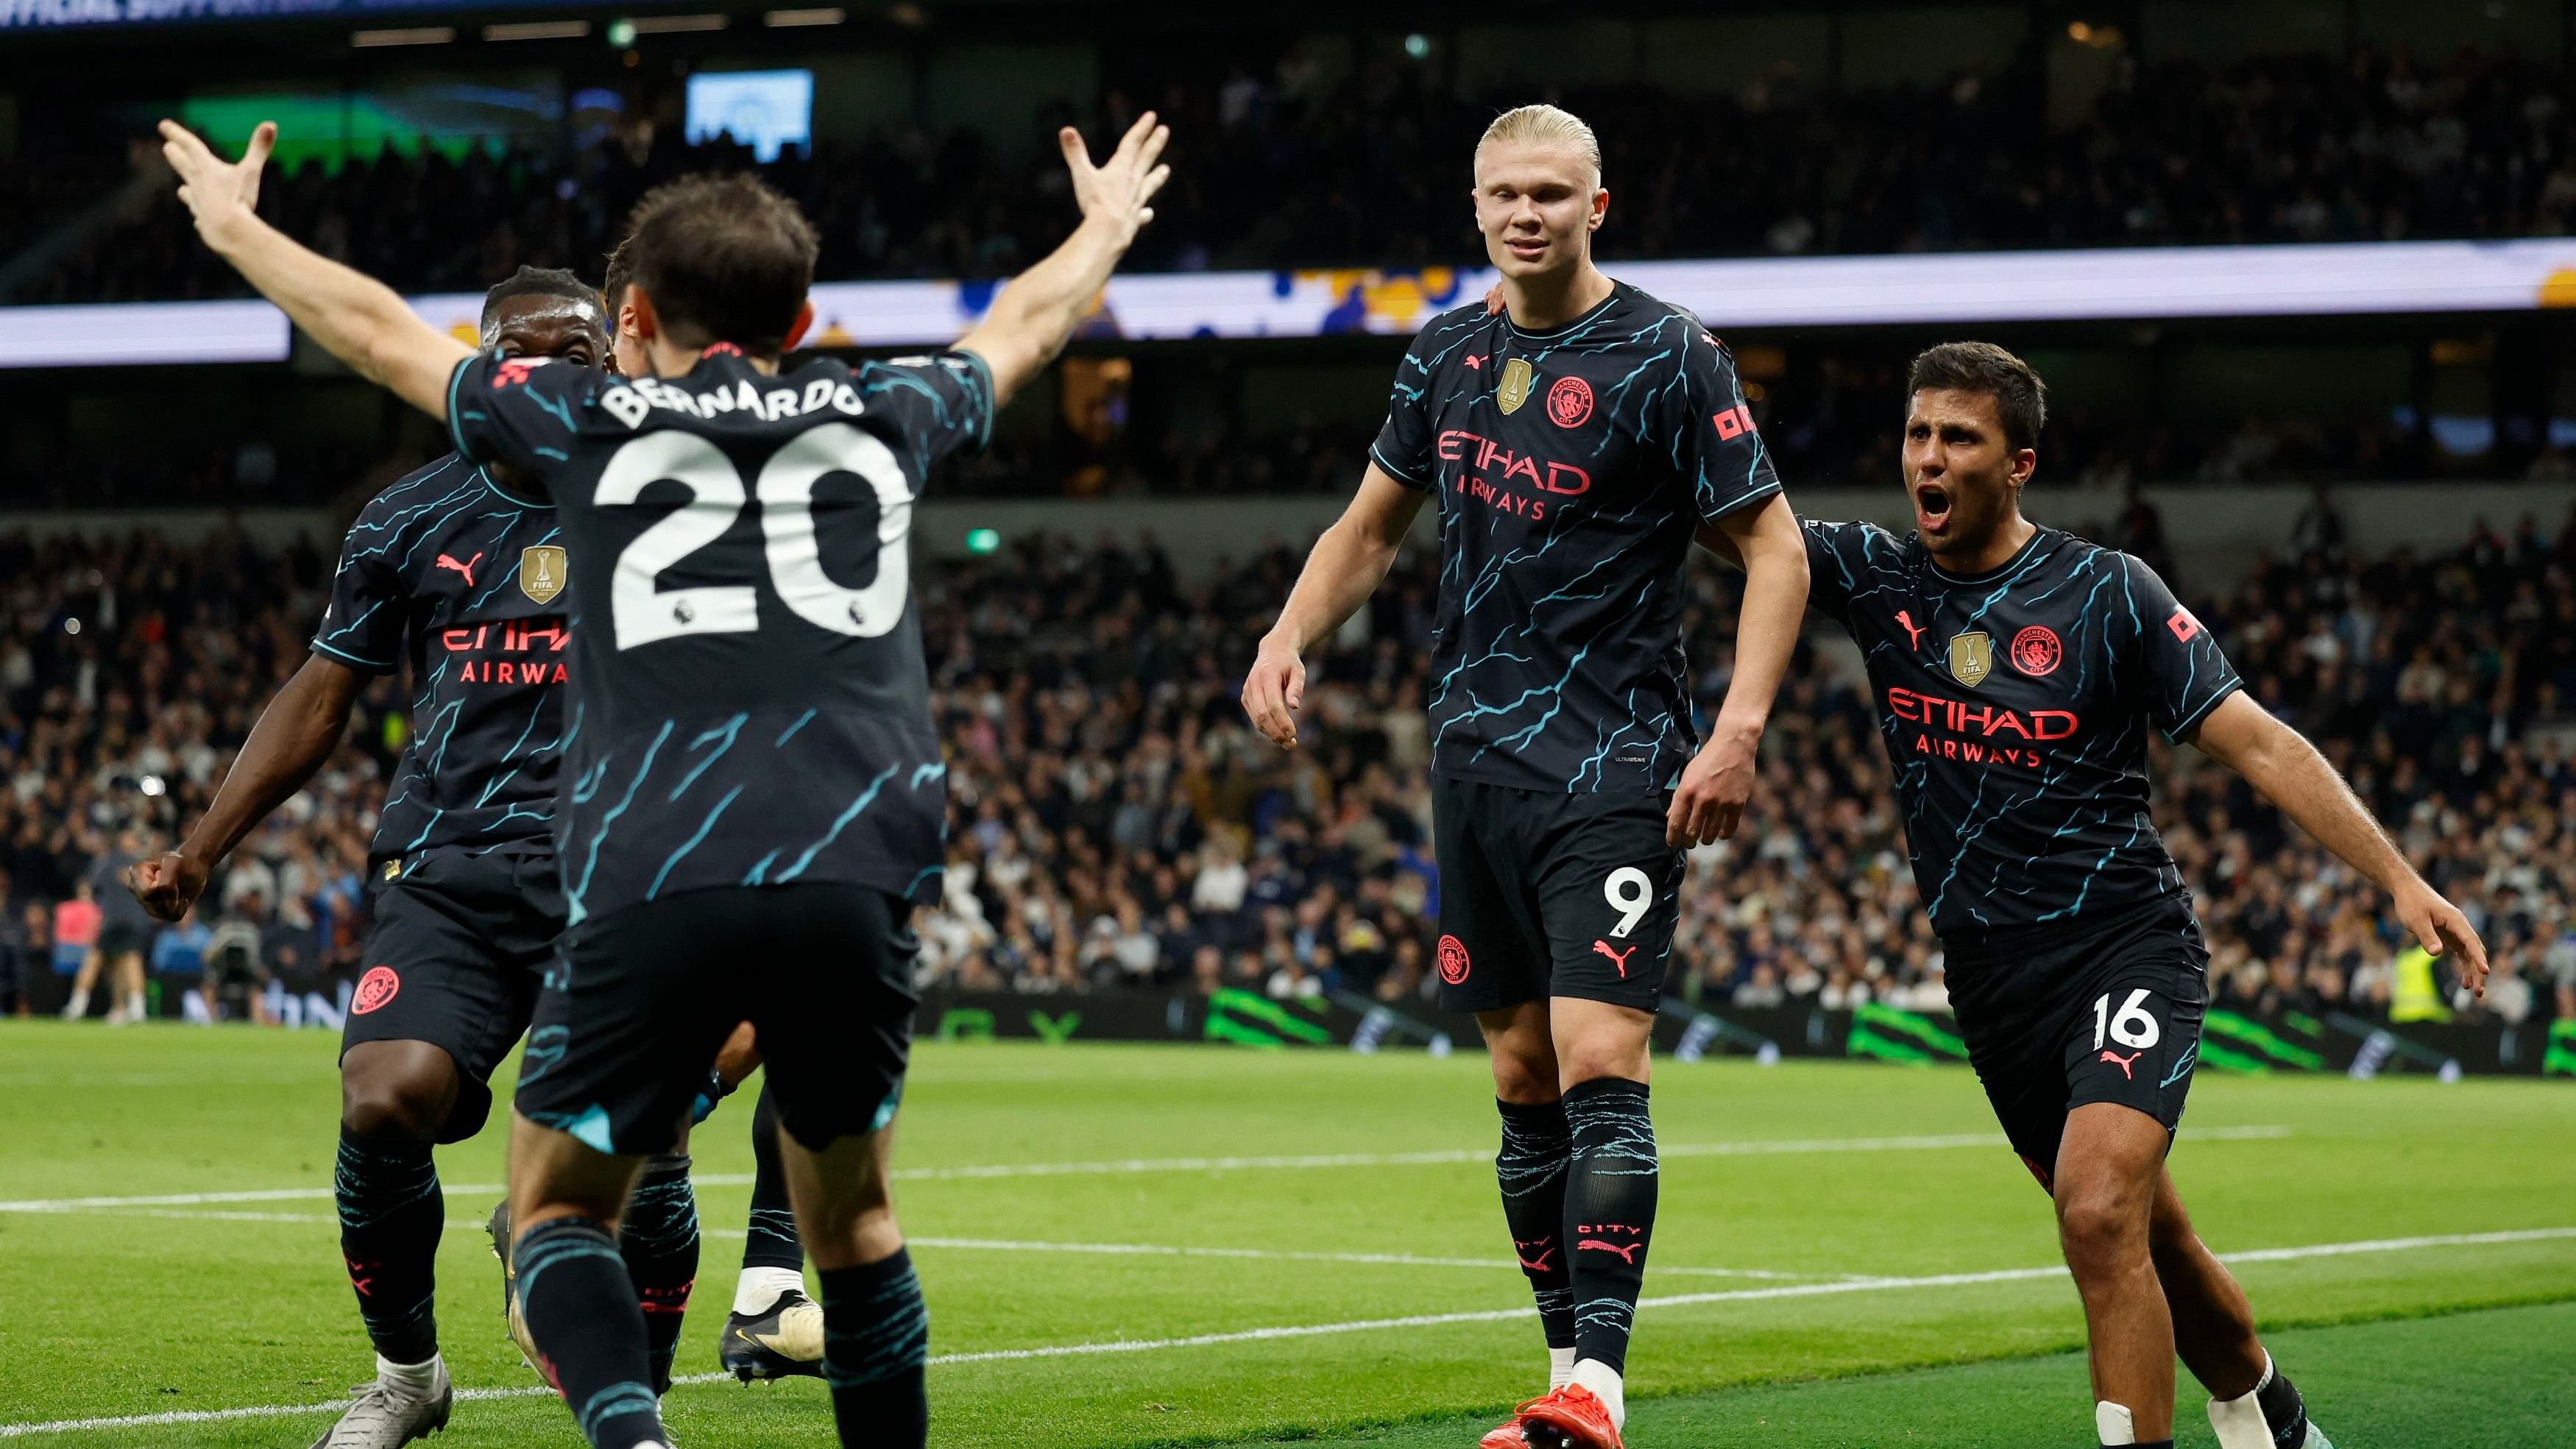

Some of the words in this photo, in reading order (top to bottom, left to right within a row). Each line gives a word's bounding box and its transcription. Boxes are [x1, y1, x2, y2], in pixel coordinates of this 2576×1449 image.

[601, 378, 866, 430] BERNARDO
[1504, 392, 1518, 403] FIFA
[1555, 380, 1589, 400] MANCHESTER
[1438, 430, 1590, 496] ETIHAD
[1457, 474, 1546, 521] IRWAYS
[593, 422, 915, 651] 20
[532, 581, 553, 589] FIFA
[2017, 629, 2056, 647] MANCHESTER
[1963, 665, 1981, 675] FIFA
[1888, 687, 2078, 740] ETIHAD
[1915, 734, 2042, 768] AIRWAYS
[1604, 866, 1653, 938] 9
[2092, 988, 2160, 1052] 16
[1577, 1224, 1641, 1236] CITY
